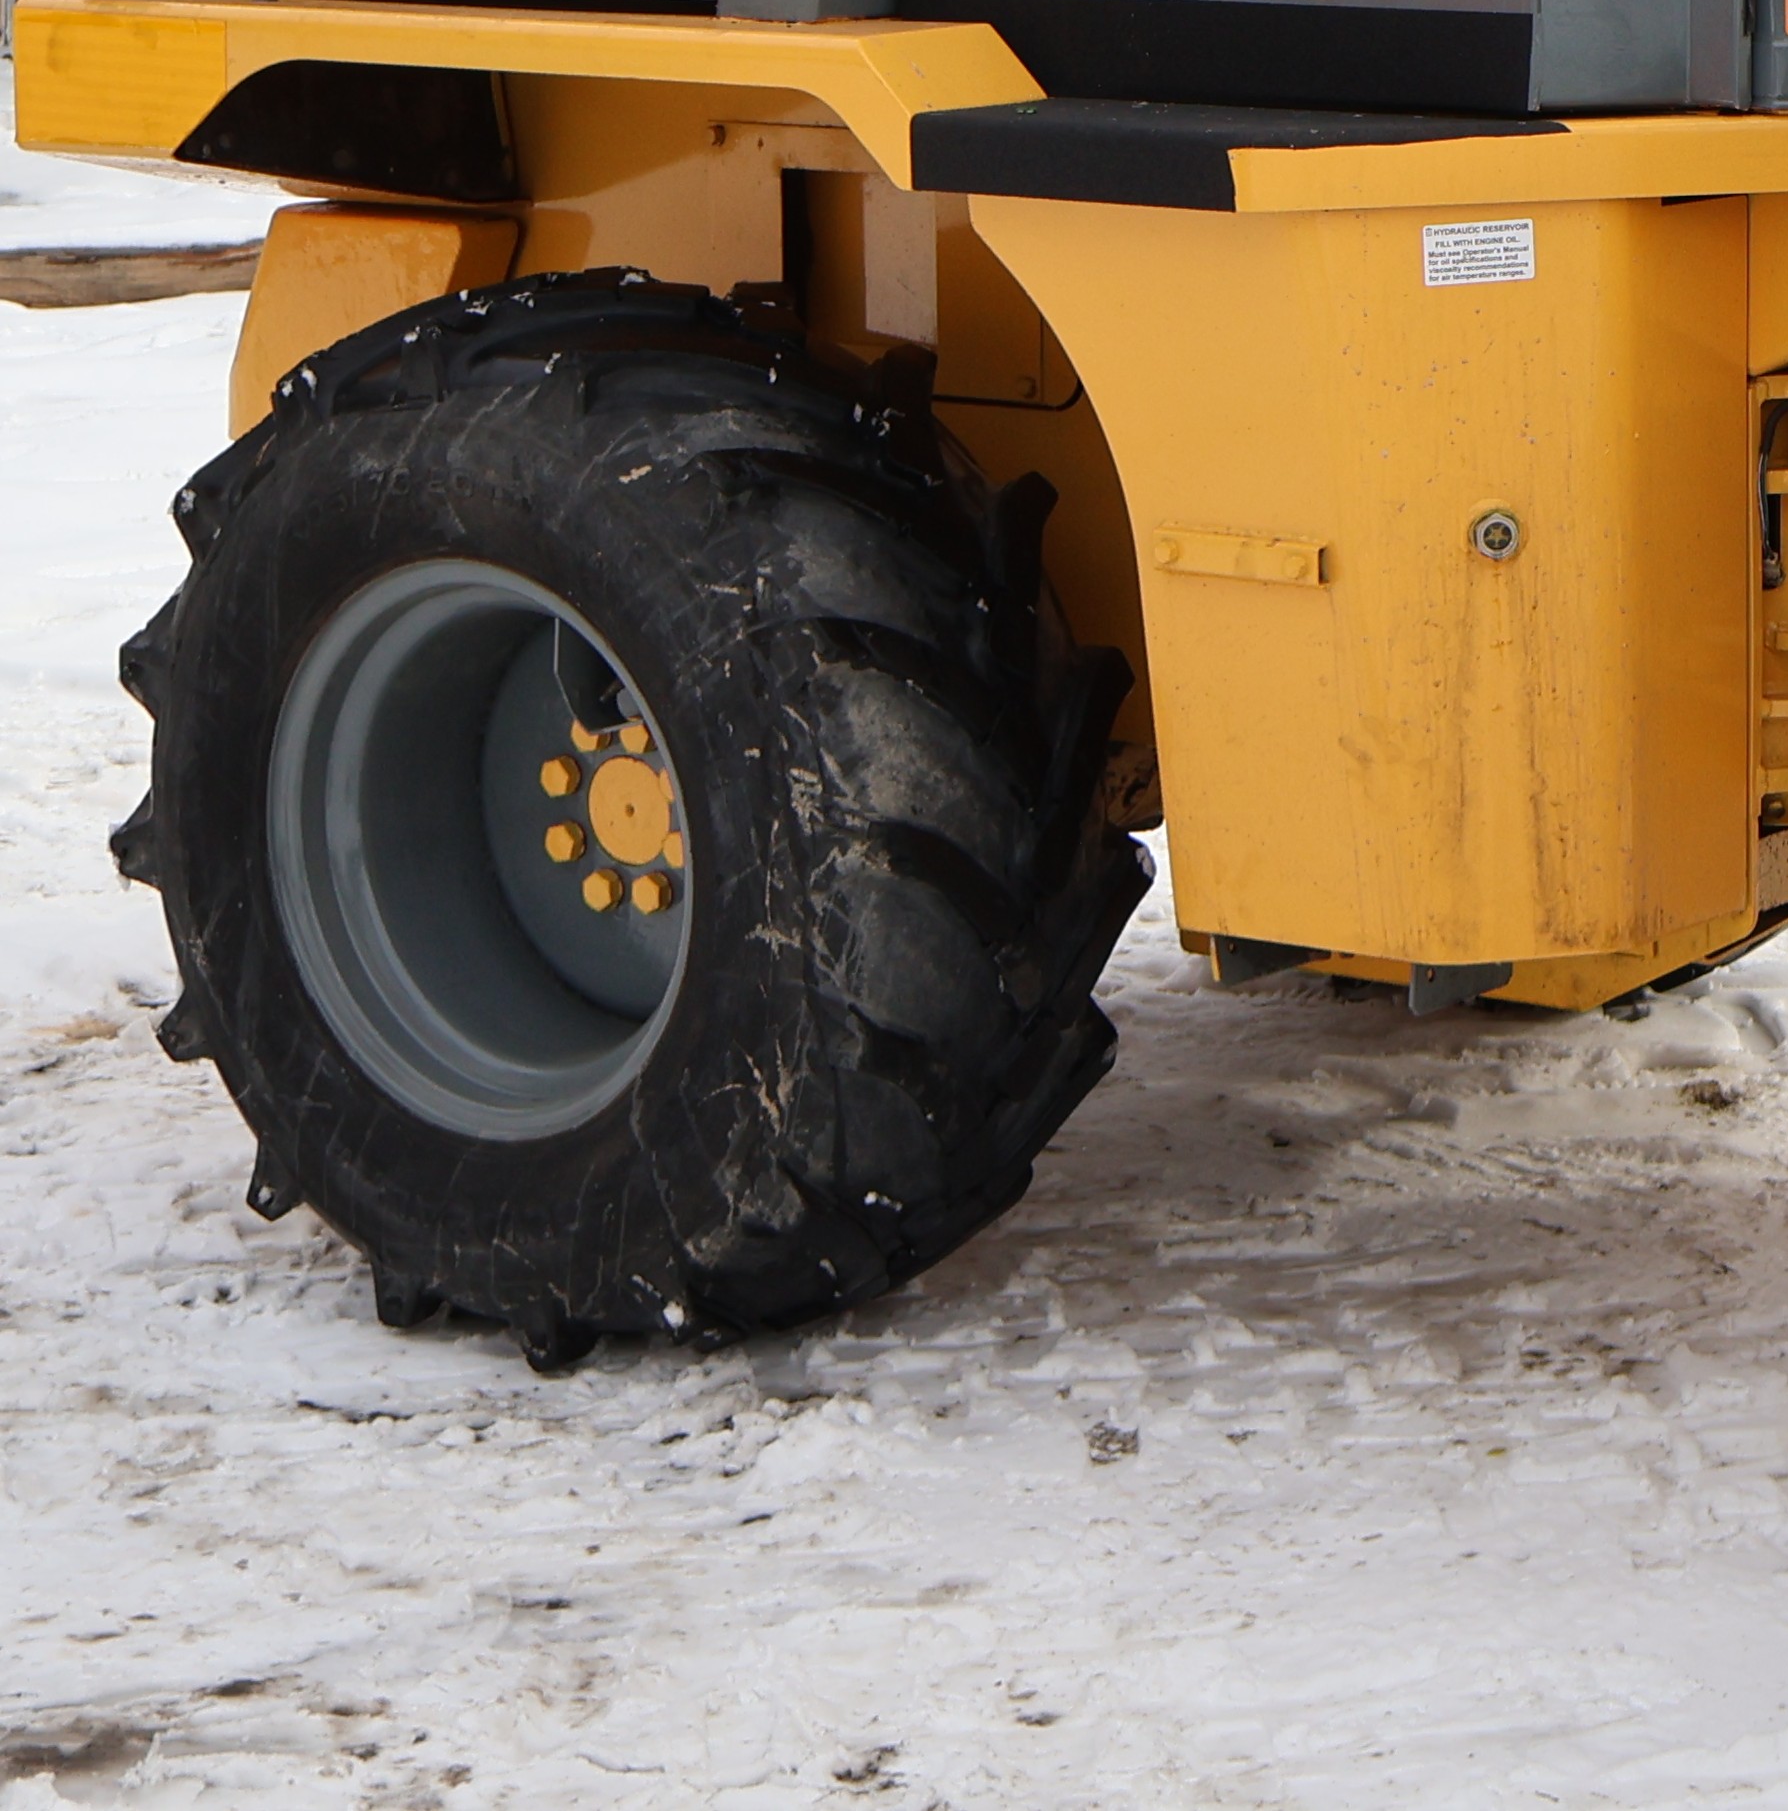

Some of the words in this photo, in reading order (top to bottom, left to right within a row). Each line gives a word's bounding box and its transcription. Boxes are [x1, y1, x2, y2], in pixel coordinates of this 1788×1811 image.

[1434, 226, 1480, 236] HYDRAULIC
[1482, 222, 1529, 233] RESERVOIR
[1453, 239, 1473, 247] WITH
[1474, 237, 1503, 246] ENGINE
[1462, 247, 1501, 256] Operator's
[1503, 245, 1530, 253] Manual
[1452, 255, 1502, 265] specifications
[1429, 265, 1462, 274] viscosity
[1463, 262, 1529, 271] recommendations
[1453, 271, 1497, 280] temperature
[1499, 270, 1526, 278] ranges.
